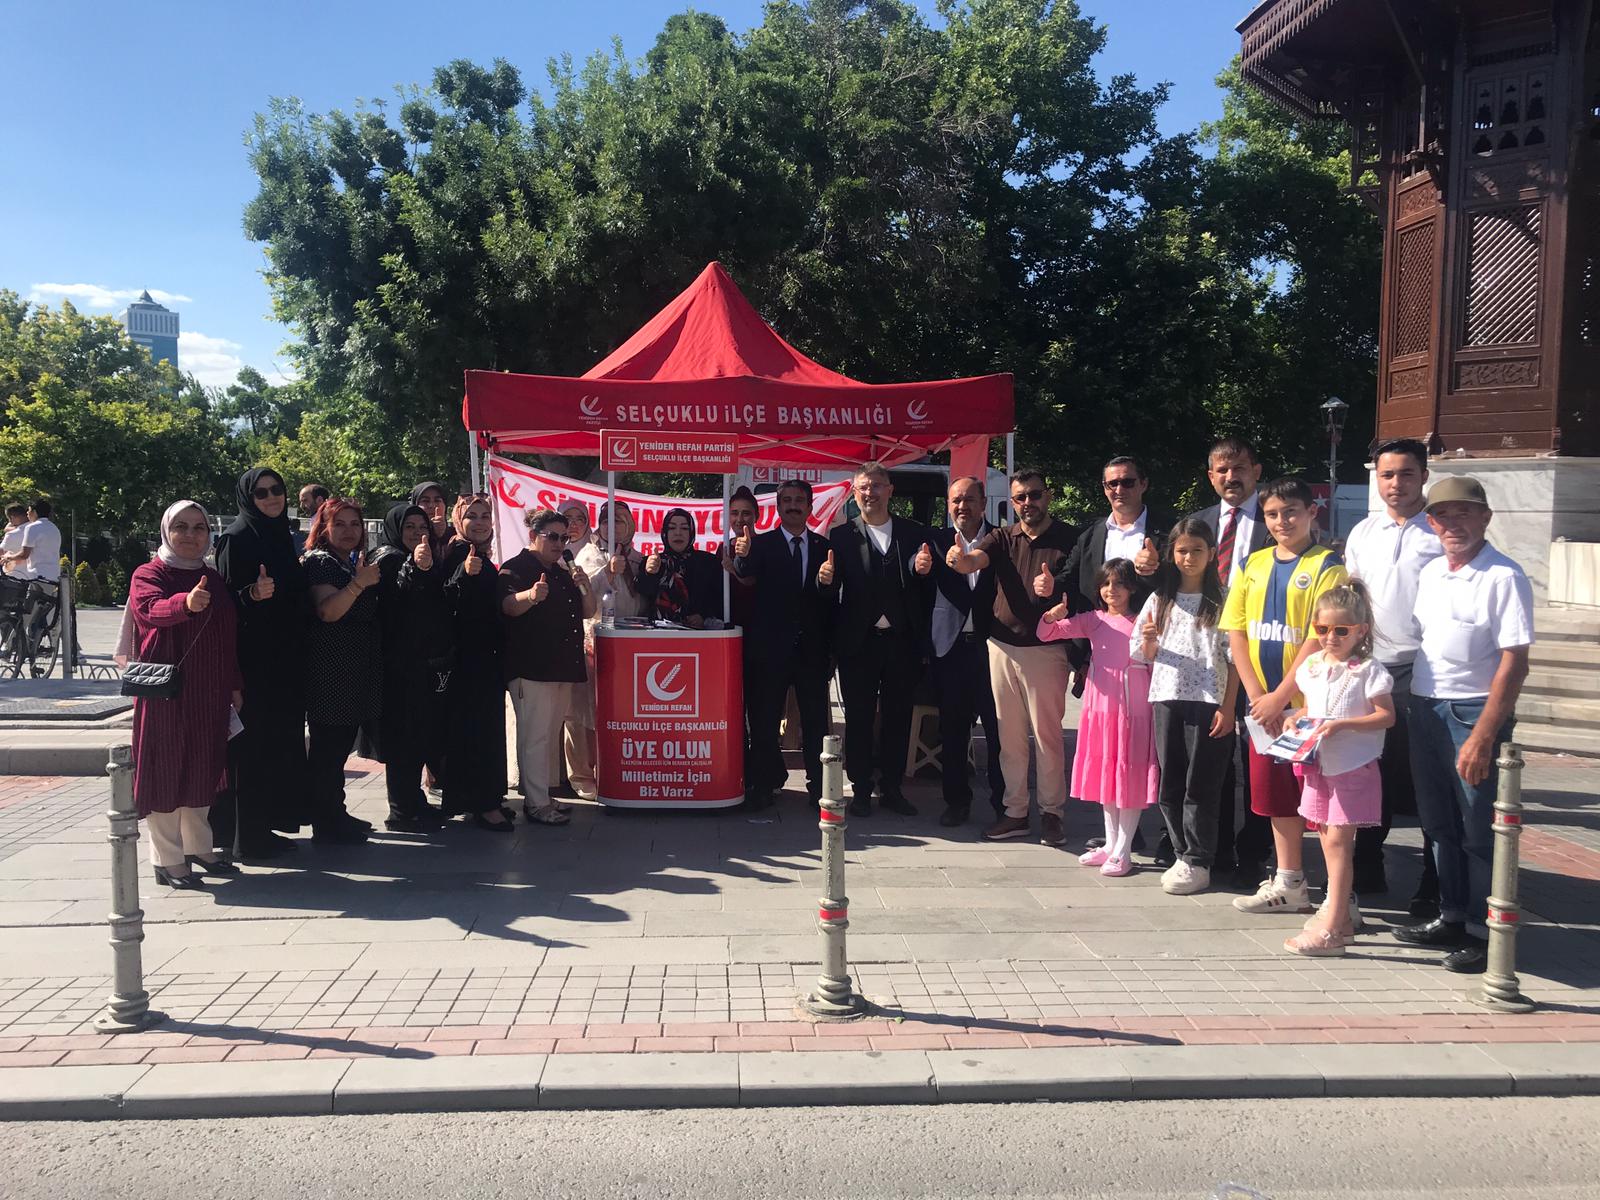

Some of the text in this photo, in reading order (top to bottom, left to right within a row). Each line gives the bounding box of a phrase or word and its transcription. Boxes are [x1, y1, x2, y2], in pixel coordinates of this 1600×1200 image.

[616, 405, 717, 427] SELÇUKLU
[778, 403, 892, 429] BAŞKANLIĞI
[639, 441, 735, 453] YENİDEN REFAH PARTİSİ
[643, 454, 676, 464] SELÇUKLU
[640, 703, 669, 711] YENİDEN
[606, 720, 728, 733] SELÇUKLU İLÇE BAŞKANLIĞI
[622, 738, 711, 759] ÜYE OLUN
[622, 769, 711, 785] Milletimiz İçin
[639, 786, 694, 797] Biz Varız
